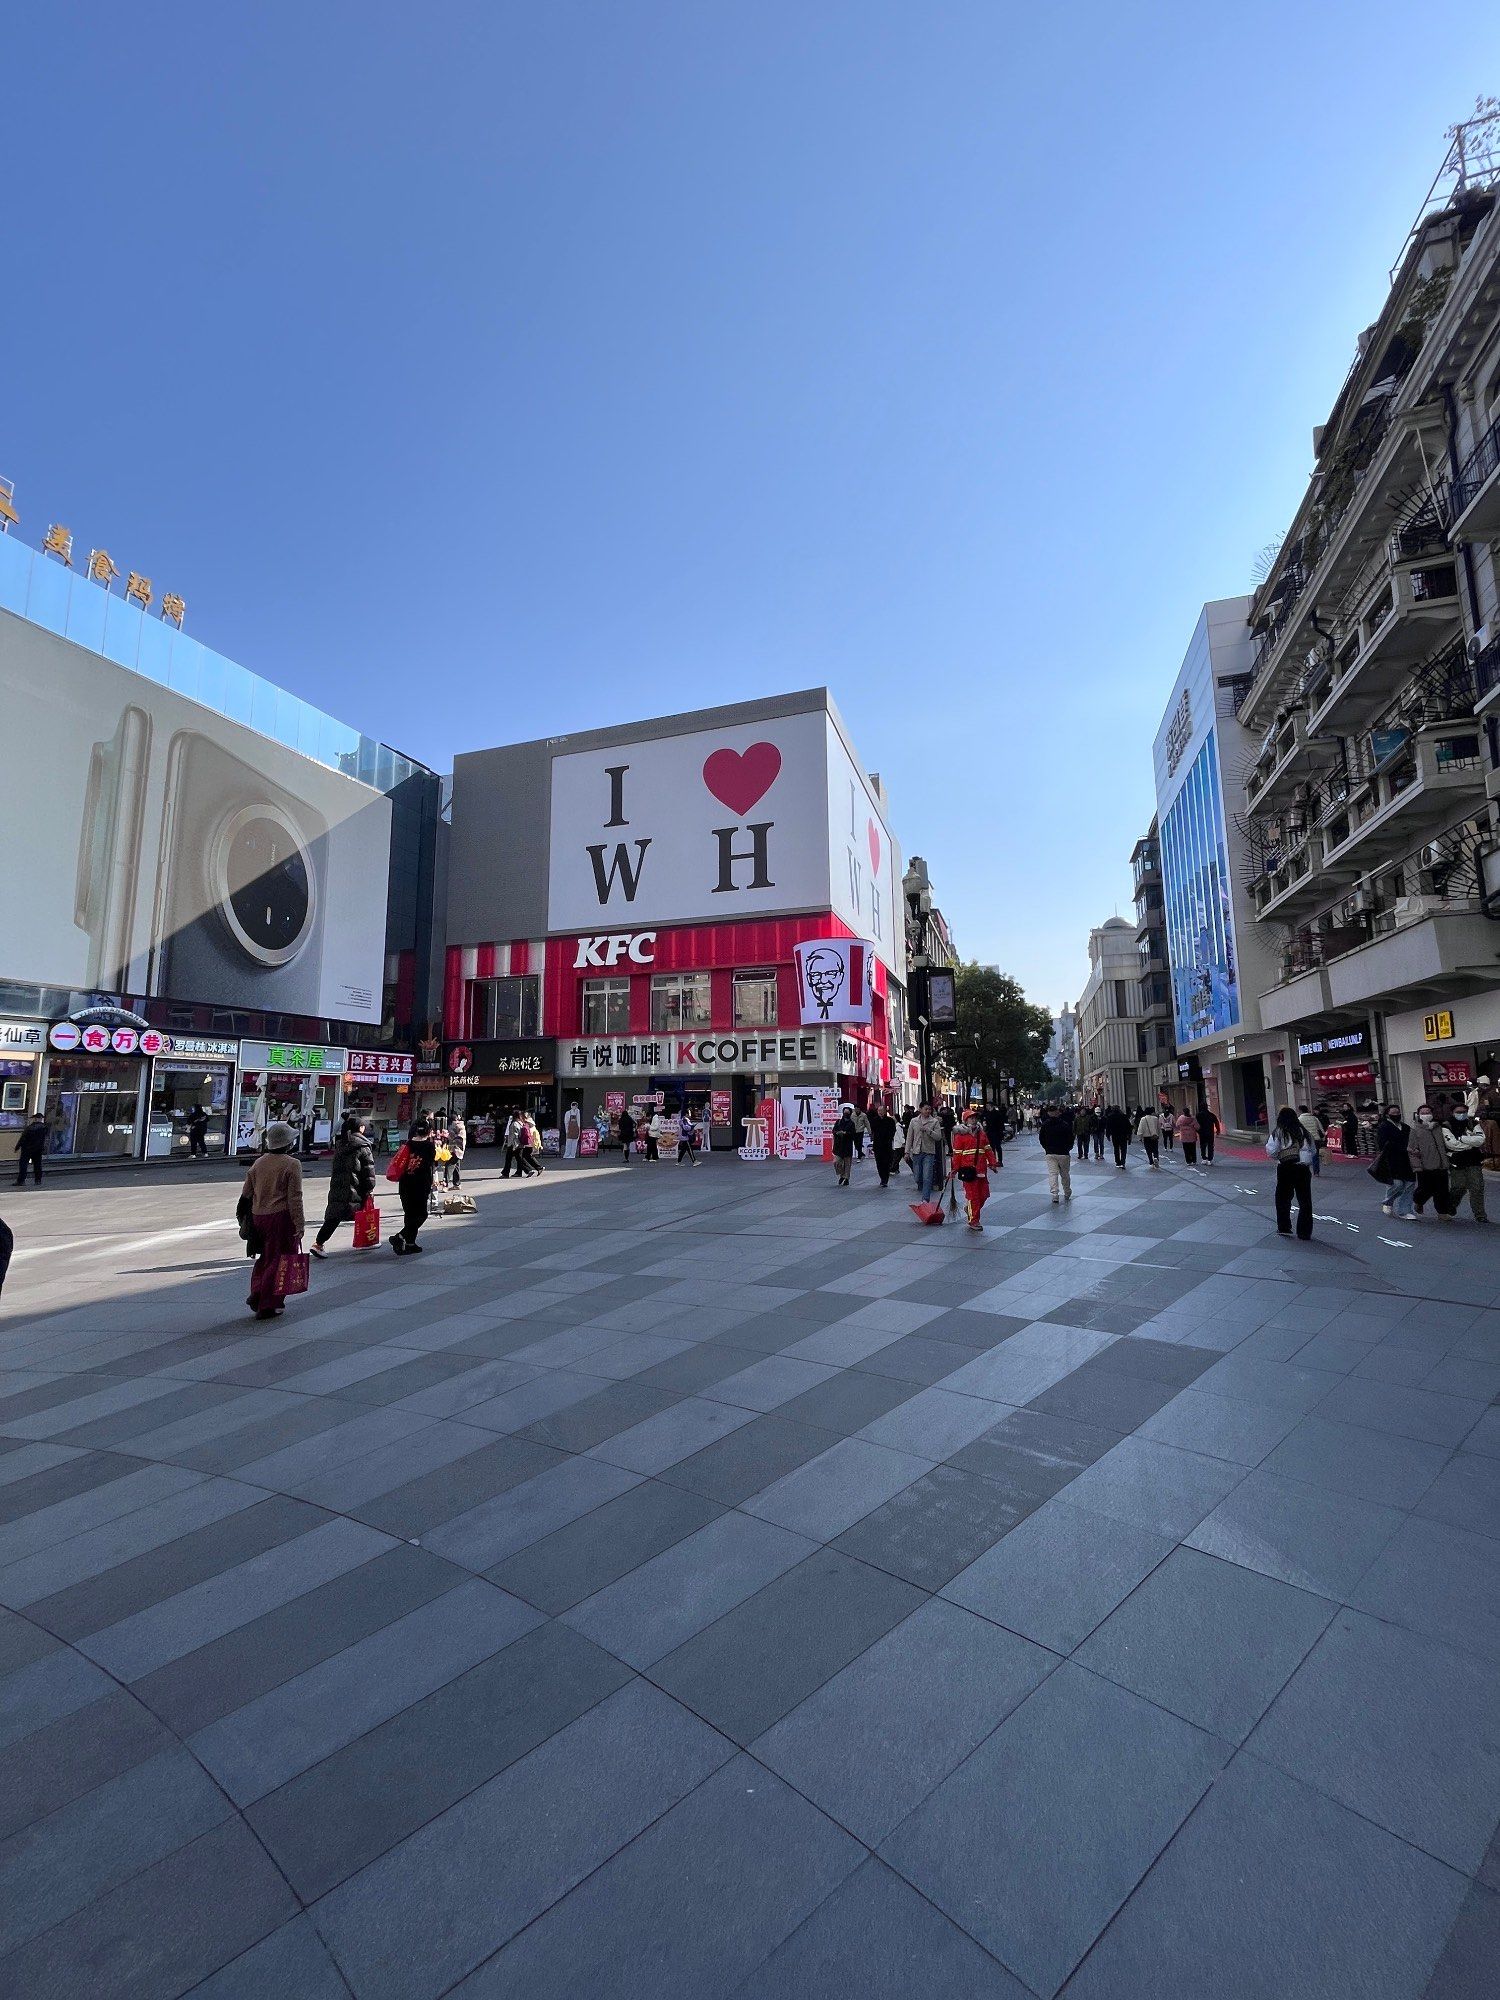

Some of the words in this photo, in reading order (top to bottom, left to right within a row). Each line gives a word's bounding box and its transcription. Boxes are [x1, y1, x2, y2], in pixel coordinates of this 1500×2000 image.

[604, 765, 629, 828] I
[573, 931, 657, 969] KFC
[54, 1029, 160, 1052] 一食万巷
[677, 1037, 817, 1065] KCOFFEE
[266, 1046, 325, 1069] 真茶屋
[364, 1055, 413, 1072] 芙蓉兴盛
[498, 1056, 541, 1072] 茶颜悦色
[570, 1042, 661, 1069] 肯悦咖啡
